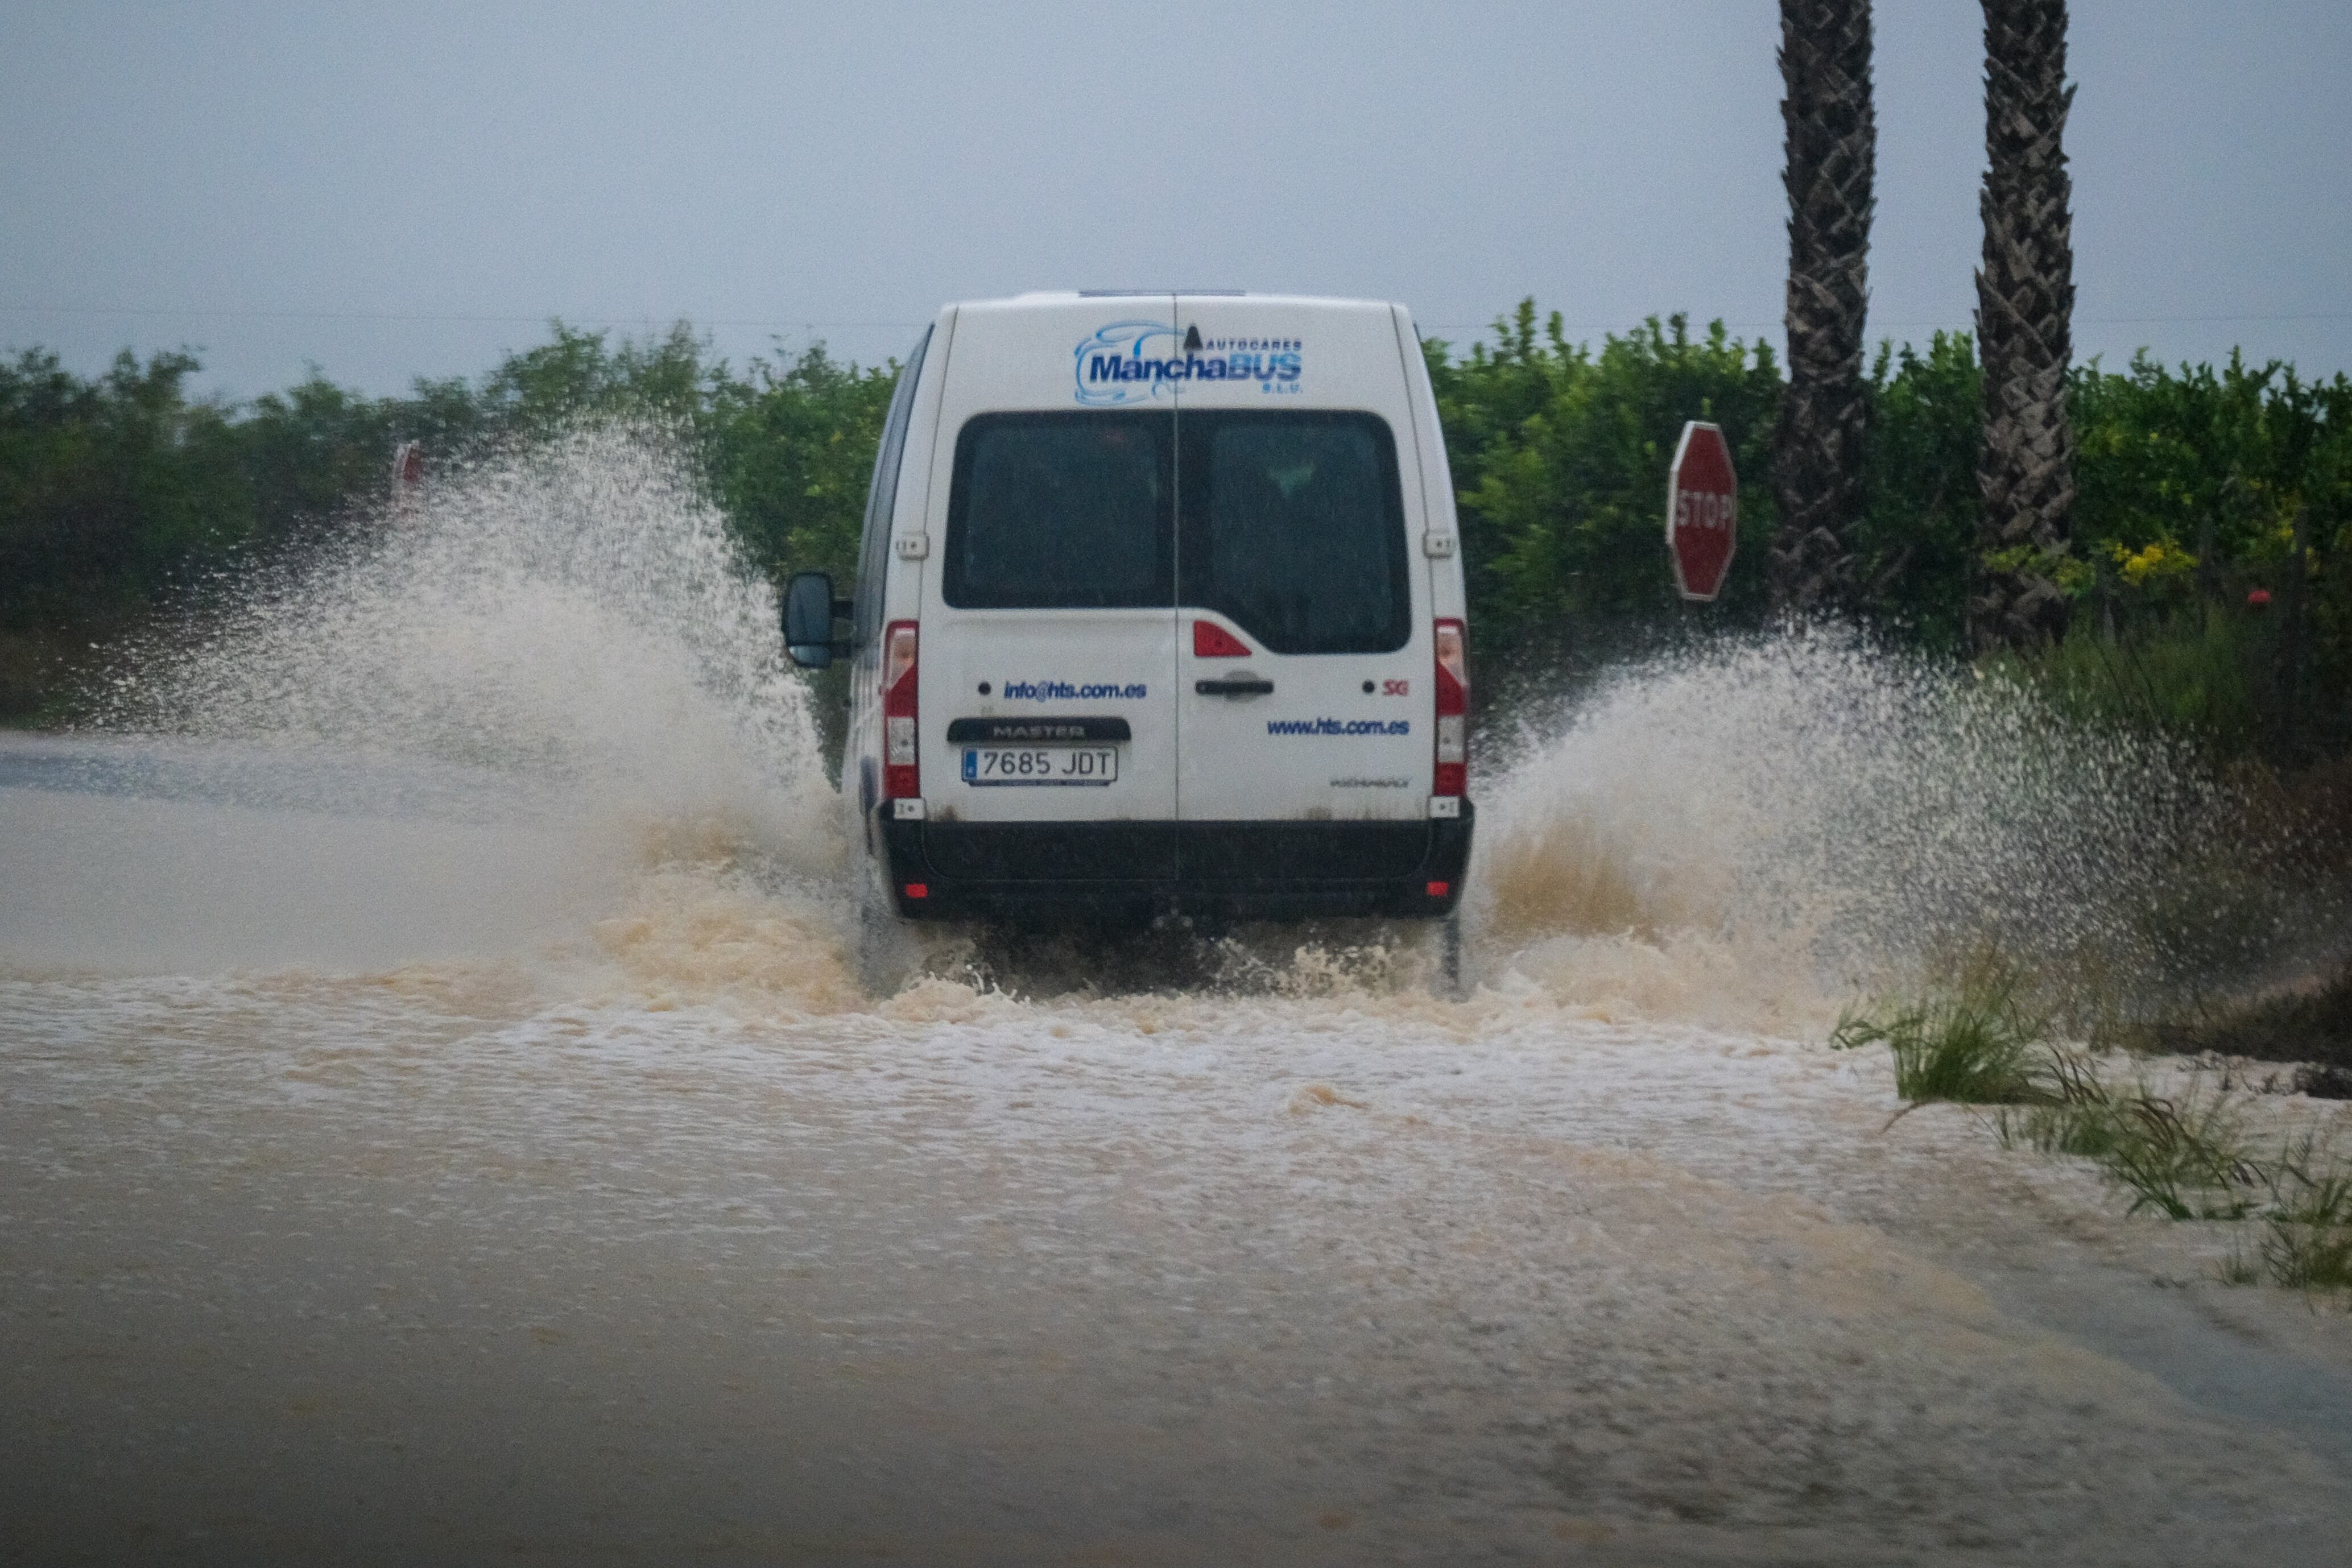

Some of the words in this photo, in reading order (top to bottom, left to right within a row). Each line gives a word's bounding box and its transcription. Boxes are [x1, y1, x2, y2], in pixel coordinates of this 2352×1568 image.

[1206, 338, 1301, 351] AUTOCARES
[1089, 352, 1301, 382] ManchaBUS
[1677, 490, 1733, 530] STOP
[1003, 681, 1147, 702] info@hts.com.es
[993, 725, 1086, 738] MASTER
[1267, 717, 1410, 735] www.hts.com.es
[983, 752, 1051, 774] 7685
[1062, 752, 1110, 775] JDT
